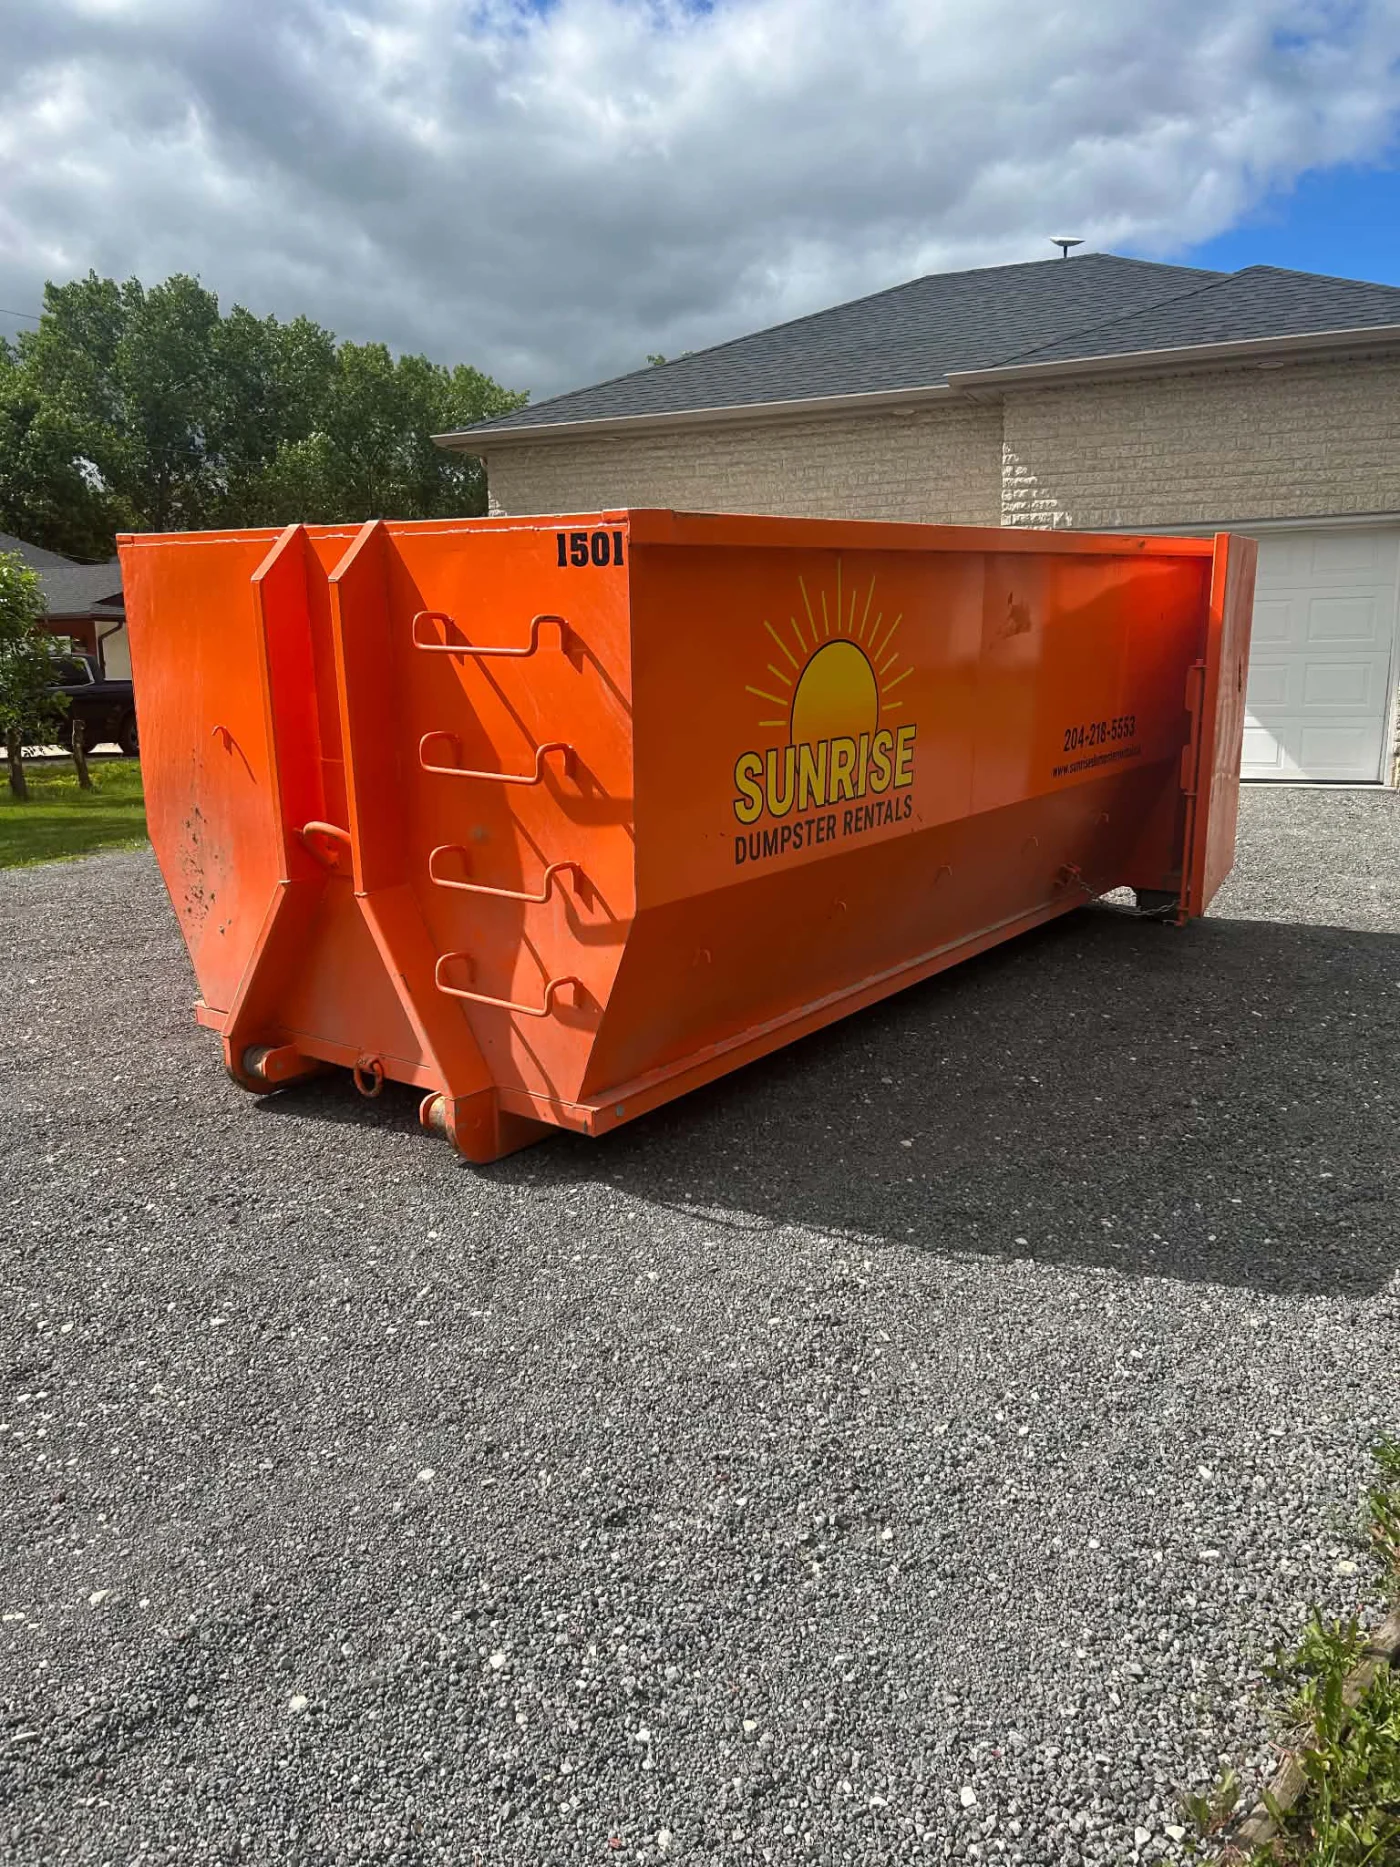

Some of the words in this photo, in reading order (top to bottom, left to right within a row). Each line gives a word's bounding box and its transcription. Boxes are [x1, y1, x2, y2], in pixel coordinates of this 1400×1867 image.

[556, 531, 624, 567] 1501
[1063, 715, 1136, 752] 204-218-5553
[733, 723, 917, 825] SUNRISE
[735, 814, 836, 865] DUMPSTER
[843, 795, 913, 836] RENTALS
